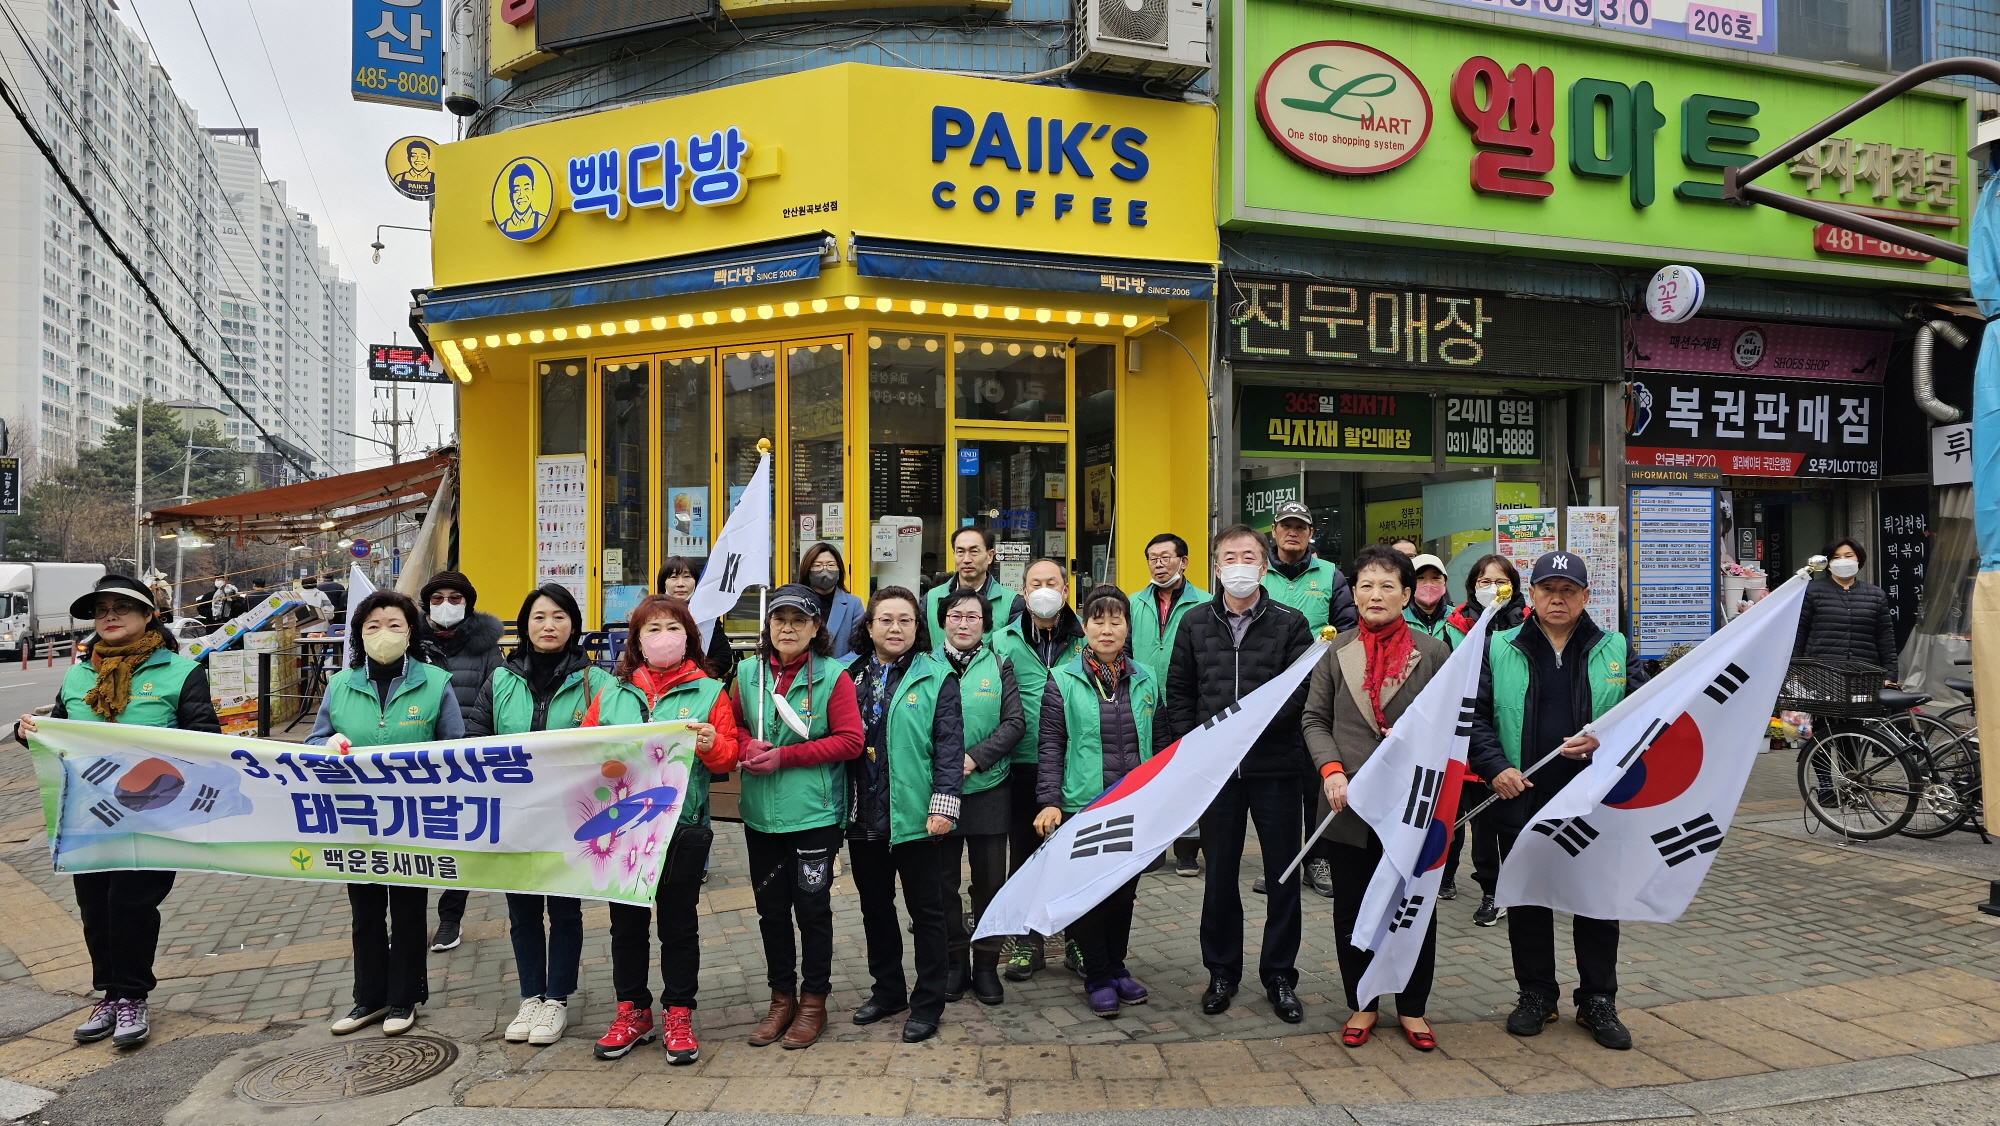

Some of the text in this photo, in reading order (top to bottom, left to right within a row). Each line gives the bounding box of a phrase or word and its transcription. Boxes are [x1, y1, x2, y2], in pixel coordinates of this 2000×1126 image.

[365, 0, 433, 64] 산
[1694, 8, 1754, 41] 206호
[356, 66, 439, 97] 485-8080
[1360, 113, 1412, 136] MART
[1450, 55, 1760, 209] 엘마트
[931, 105, 1150, 181] PAIK'S
[1287, 127, 1405, 151] One stop shopping system
[567, 124, 748, 221] 빽다방
[1786, 137, 1960, 207] 식자재전문
[782, 200, 839, 219] 안산원곡보성점
[931, 181, 1148, 227] COFFEE
[222, 226, 239, 236] 101
[713, 265, 797, 286] 빽다방 SINCE 2006
[1100, 274, 1191, 297] 빽다방 SINCE 2006
[1657, 281, 1677, 315] 꽃
[1230, 281, 1493, 365] 전문매장
[1668, 335, 1722, 352] 패션수제화
[1736, 344, 1761, 356] Codi
[1773, 356, 1830, 372] SHOES SHOP
[1284, 391, 1397, 417] 365일 최저가
[1447, 398, 1535, 426] 24시 영업
[1665, 386, 1870, 444] 복권판매점
[1268, 417, 1412, 450] 식자재 할인매장
[1447, 426, 1535, 455] 031) 481-8888
[1655, 452, 1792, 472] 연금복권720 엘리베이터 국민은행앞
[1808, 457, 1878, 475] 오뚜기LOTTO점
[990, 519, 1035, 530] COFFEE
[999, 509, 1036, 520] PAIK'S
[1401, 507, 1415, 519] 정부
[1883, 513, 1927, 535] 튀김천하
[1378, 518, 1422, 532] 사회적 거리두기
[1552, 554, 1569, 570] NY
[1887, 542, 1925, 559] 떡볶이
[1888, 563, 1924, 580] 순대
[291, 793, 502, 844] 태극기달기
[322, 849, 460, 880] 백운동새마을
